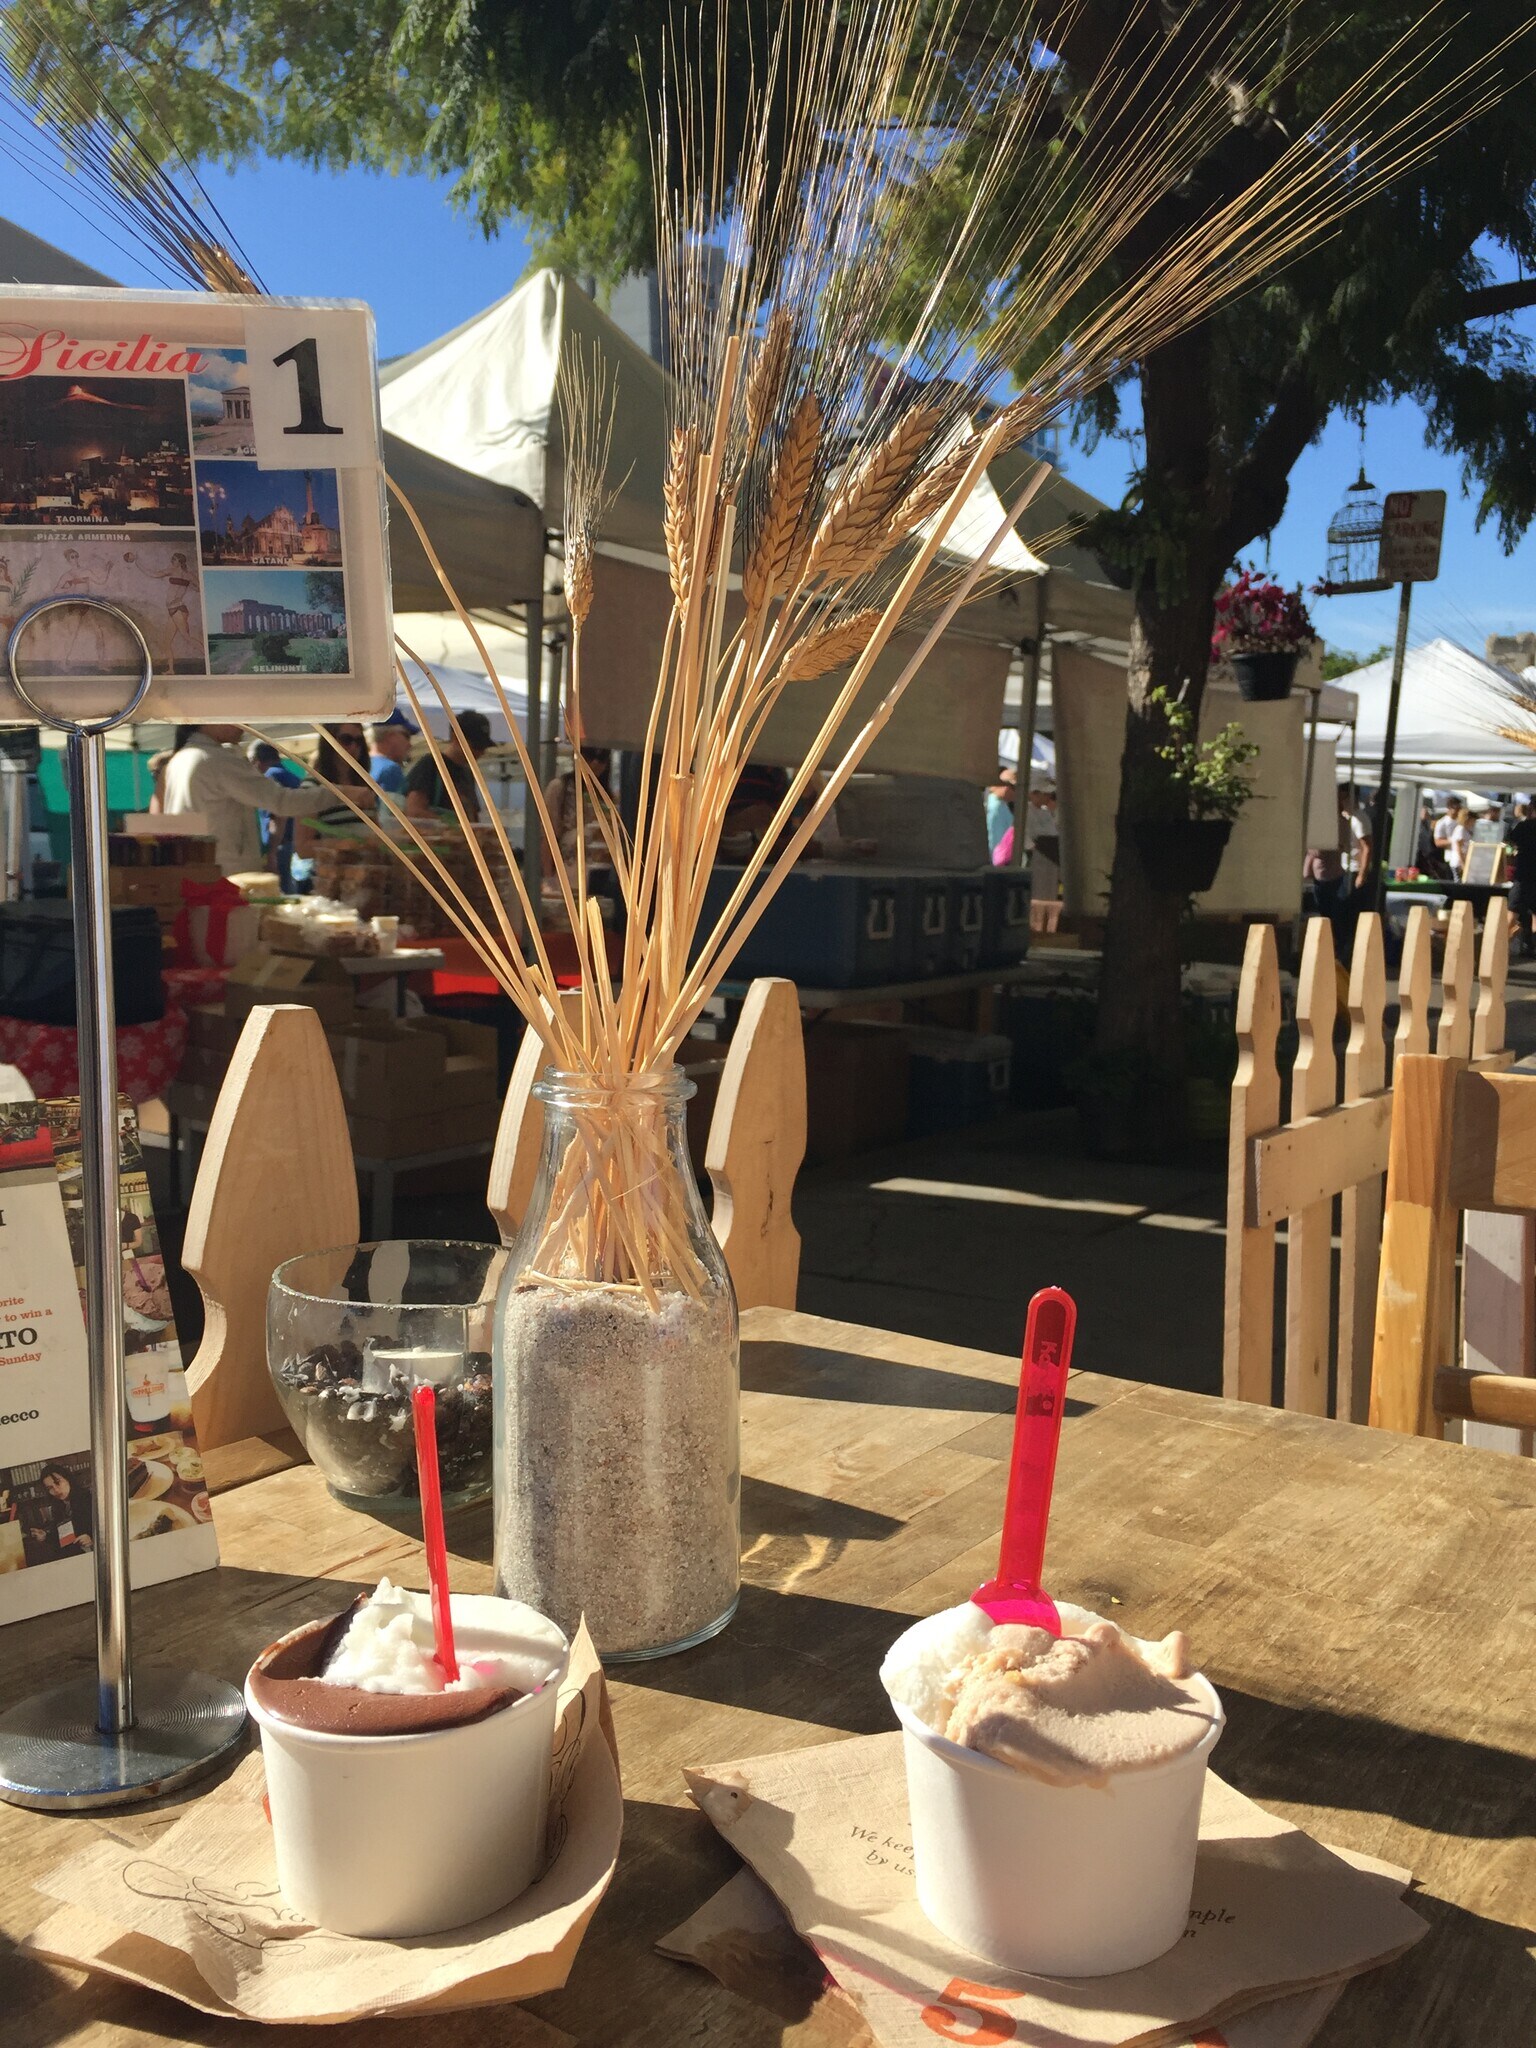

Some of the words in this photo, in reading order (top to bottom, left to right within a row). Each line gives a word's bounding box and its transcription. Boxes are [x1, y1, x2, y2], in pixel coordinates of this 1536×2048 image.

[0, 323, 209, 381] Sicilia
[272, 337, 344, 434] 1
[55, 515, 110, 523] TAORMINA
[36, 533, 74, 541] PIAZZA
[5, 1314, 17, 1322] to
[20, 1310, 42, 1319] win
[0, 1327, 38, 1350] TO
[0, 1352, 41, 1367] Sunday
[0, 1409, 40, 1426] ecco
[850, 1825, 878, 1843] We
[865, 1849, 889, 1866] by
